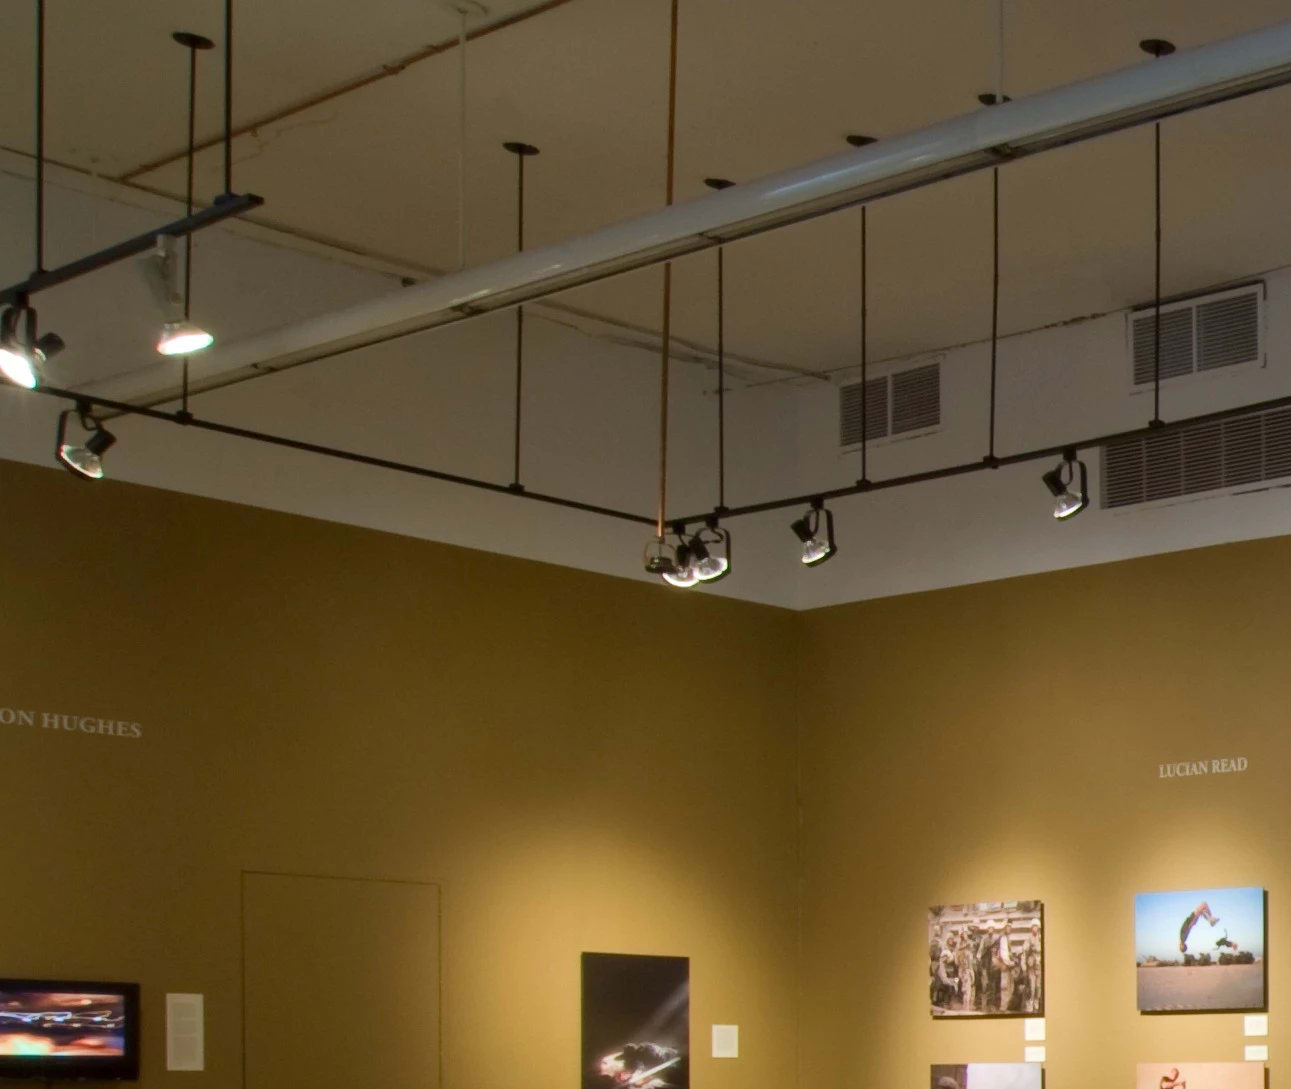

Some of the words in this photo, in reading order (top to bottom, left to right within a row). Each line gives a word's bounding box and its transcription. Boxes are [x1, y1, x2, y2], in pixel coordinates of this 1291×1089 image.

[42, 712, 142, 738] HUGHES
[1159, 760, 1209, 778] LUCIAN
[1211, 757, 1248, 773] READ
